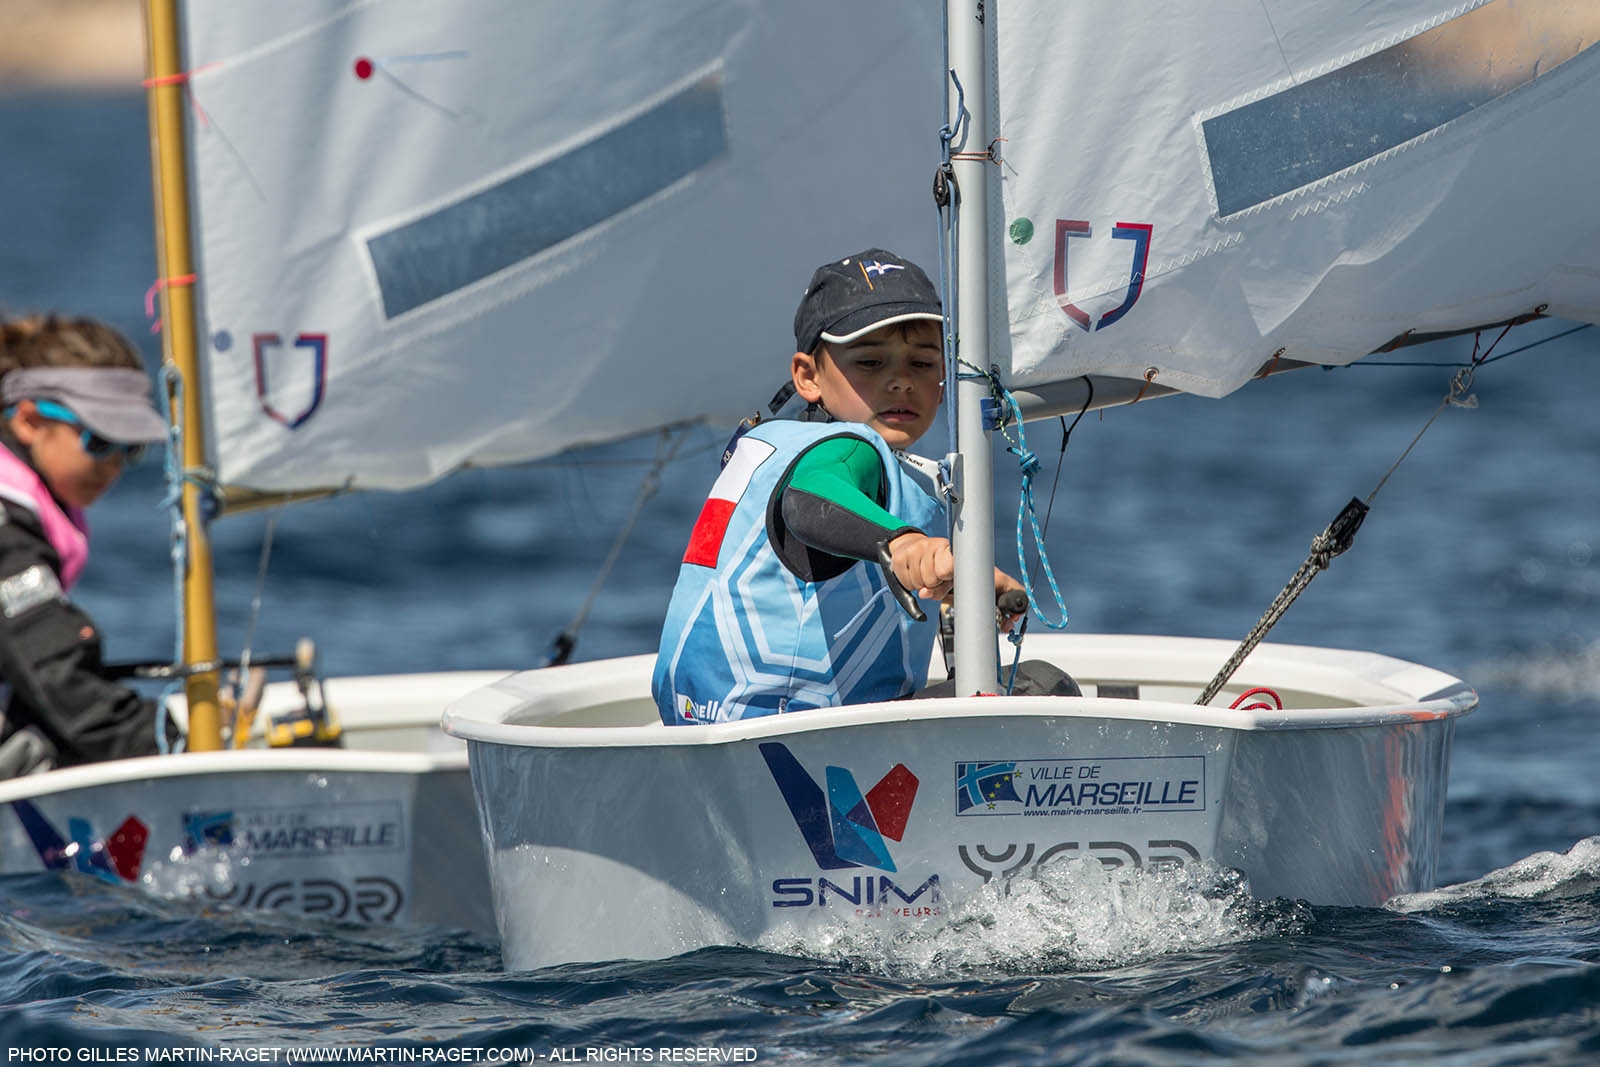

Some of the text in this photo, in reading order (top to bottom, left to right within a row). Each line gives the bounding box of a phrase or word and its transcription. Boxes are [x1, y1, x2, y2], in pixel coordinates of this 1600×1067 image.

[1030, 765, 1101, 780] VILLE DE
[1025, 780, 1199, 807] MARSEILLE
[1023, 807, 1142, 817] www.mairie-marseille.fr
[246, 823, 395, 849] MARSEILLE
[772, 874, 940, 907] SNIM
